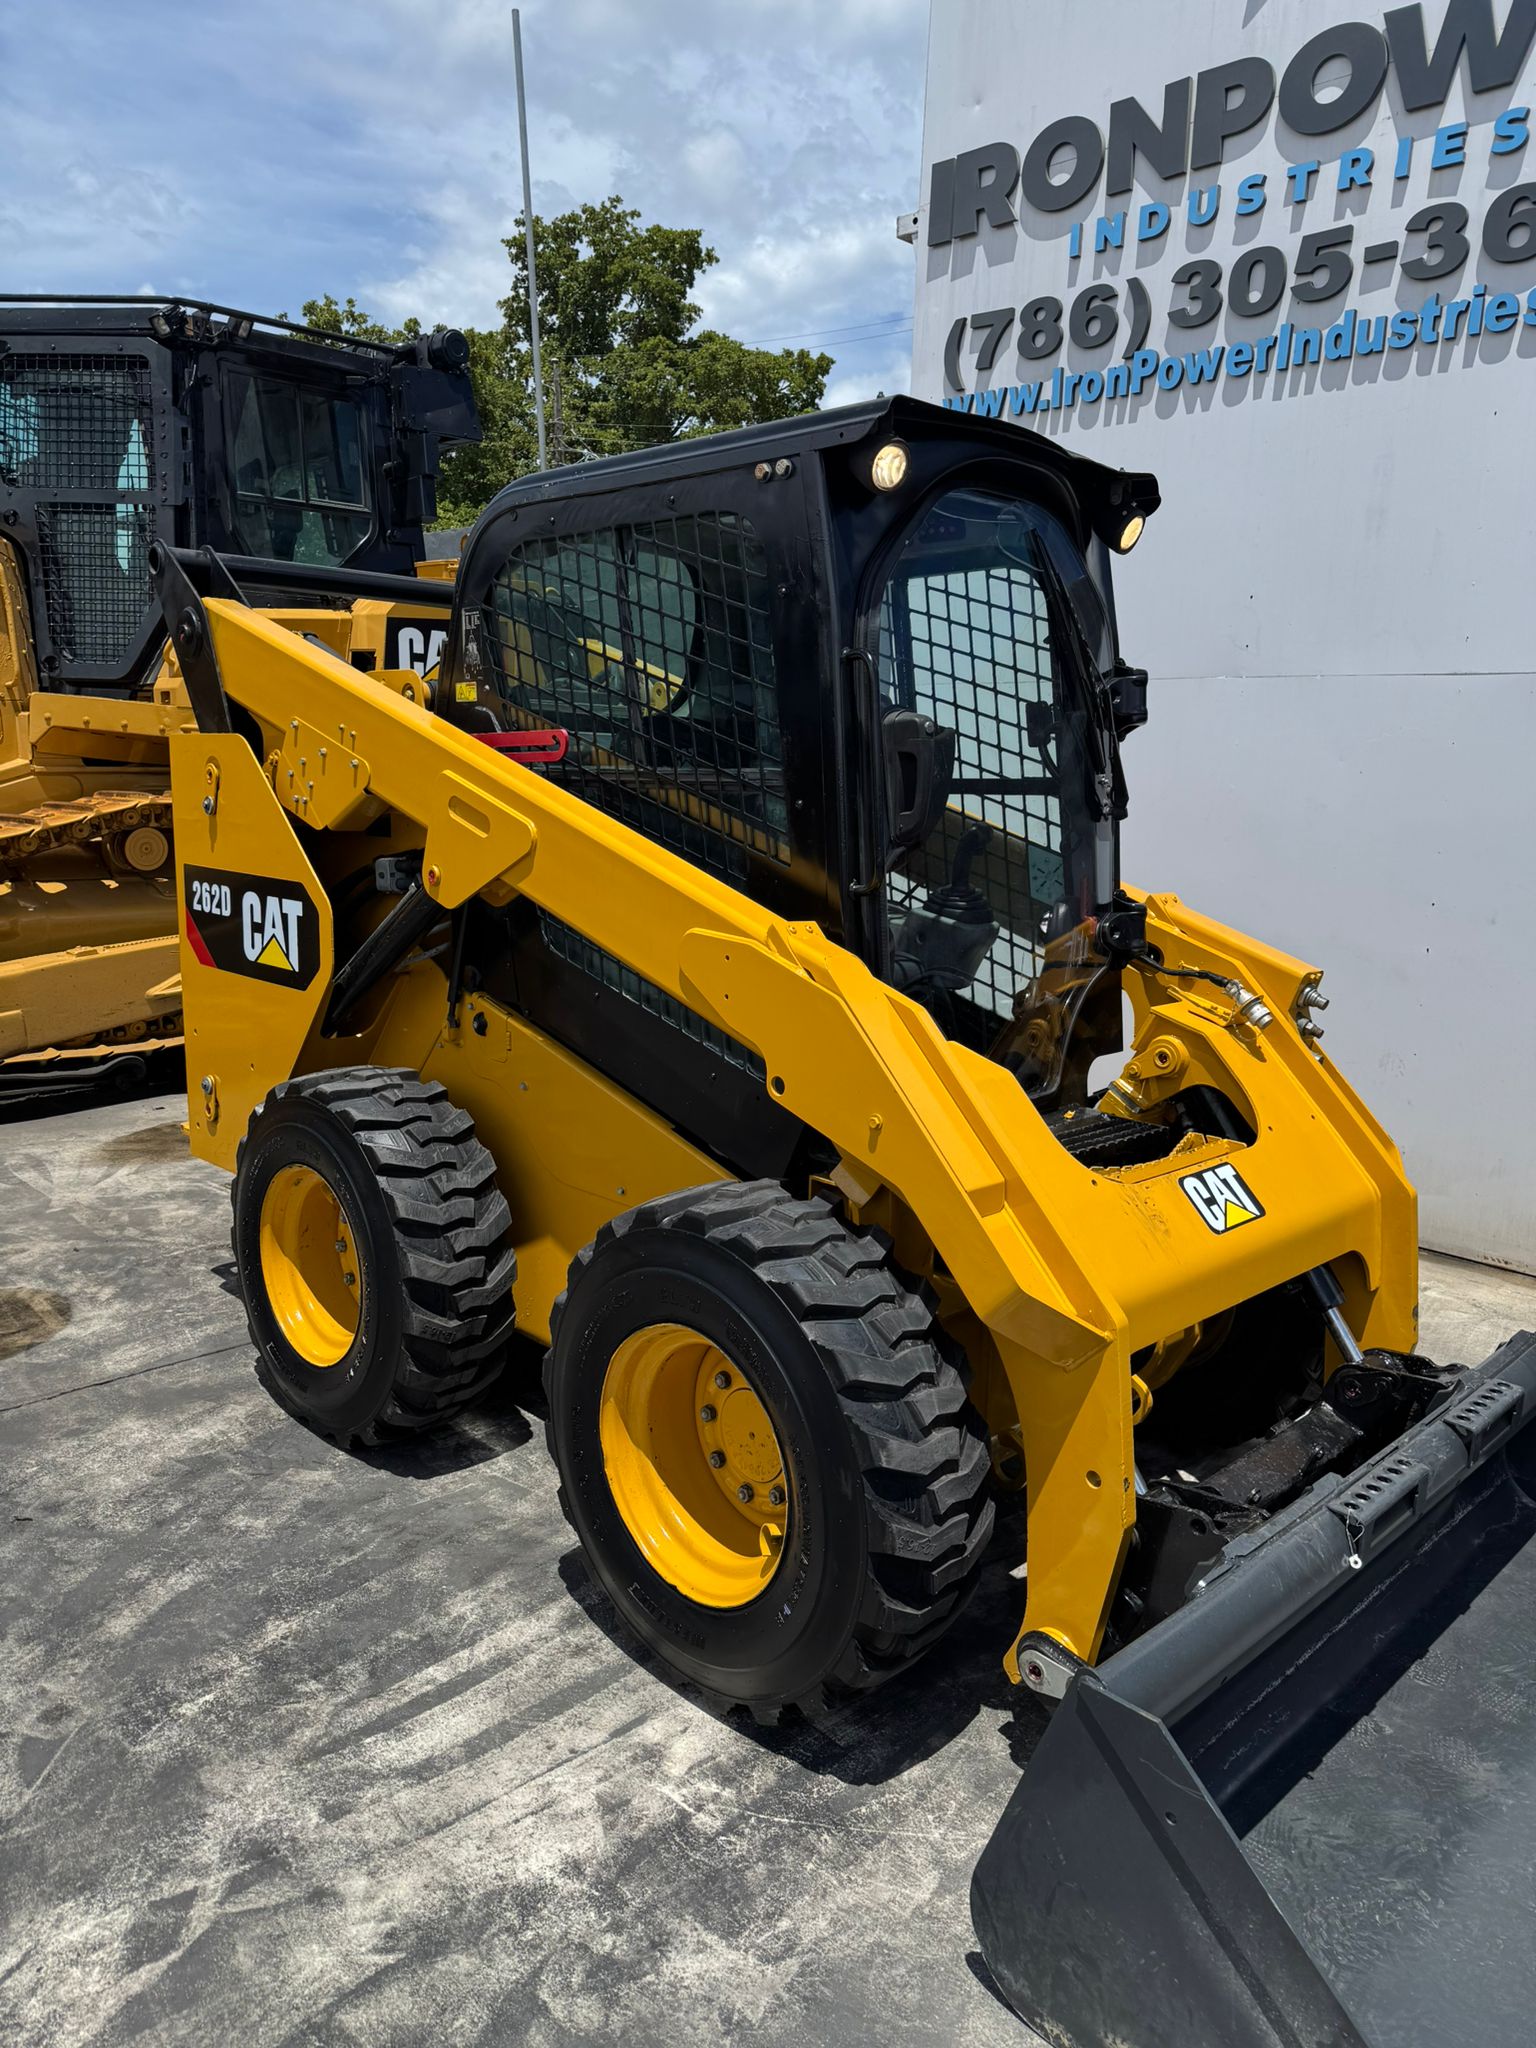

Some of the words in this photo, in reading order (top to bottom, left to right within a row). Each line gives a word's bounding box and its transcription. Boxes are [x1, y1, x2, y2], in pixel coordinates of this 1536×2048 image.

[928, 0, 1536, 248] IRONPOW
[1069, 106, 1530, 259] INDUSTRIES
[942, 278, 1152, 392] (786)
[1167, 182, 1536, 329] 305-36
[192, 880, 231, 917] 262D
[241, 890, 303, 973] CAT
[1183, 1164, 1261, 1232] CAT
